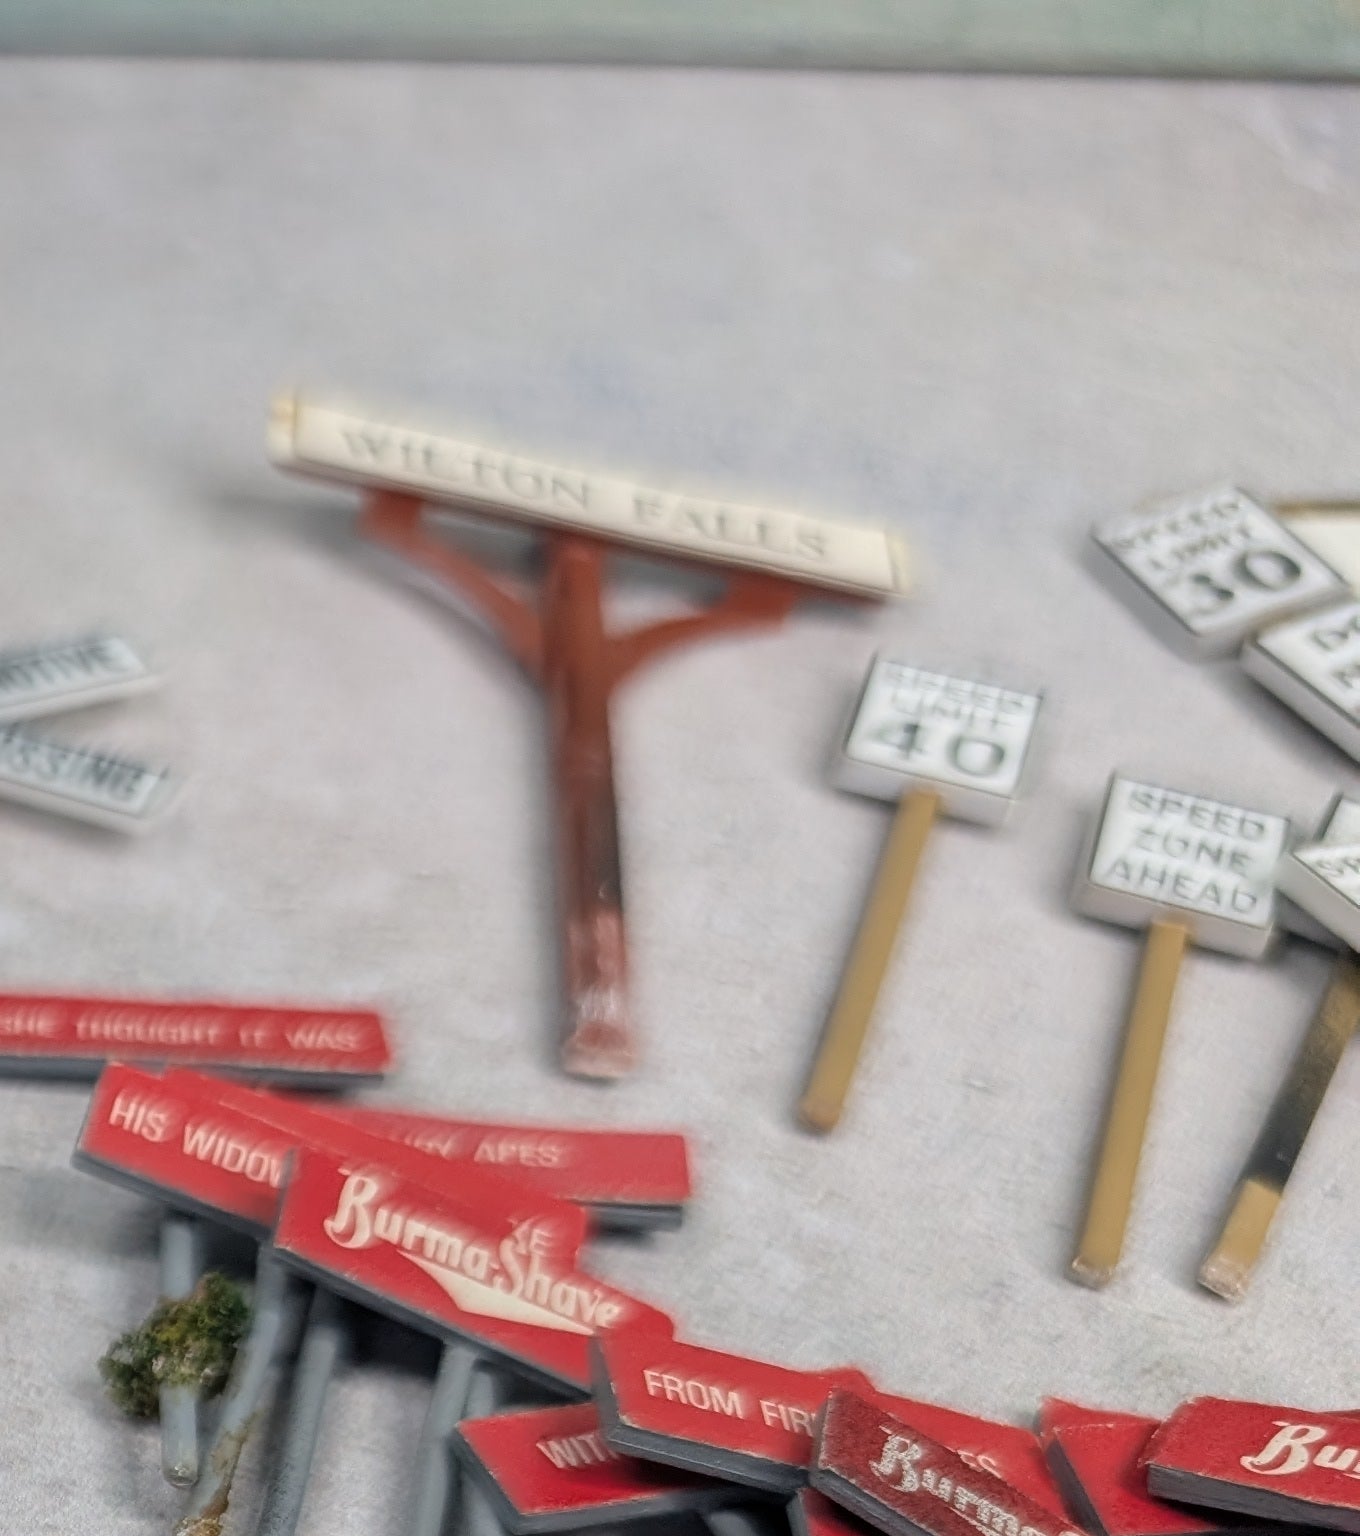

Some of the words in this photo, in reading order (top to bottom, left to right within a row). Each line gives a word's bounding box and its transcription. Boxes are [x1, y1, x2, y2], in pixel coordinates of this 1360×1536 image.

[337, 428, 591, 512] WILTON
[631, 492, 834, 562] FALLS
[1127, 788, 1267, 843] SPEED
[1134, 828, 1255, 873] ZONE
[1110, 859, 1258, 915] AHEAD
[284, 1023, 363, 1053] WAS
[107, 1093, 170, 1143] HIS
[642, 1368, 744, 1420] FROM
[759, 1399, 820, 1439] FIR
[535, 1430, 618, 1471] WIT
